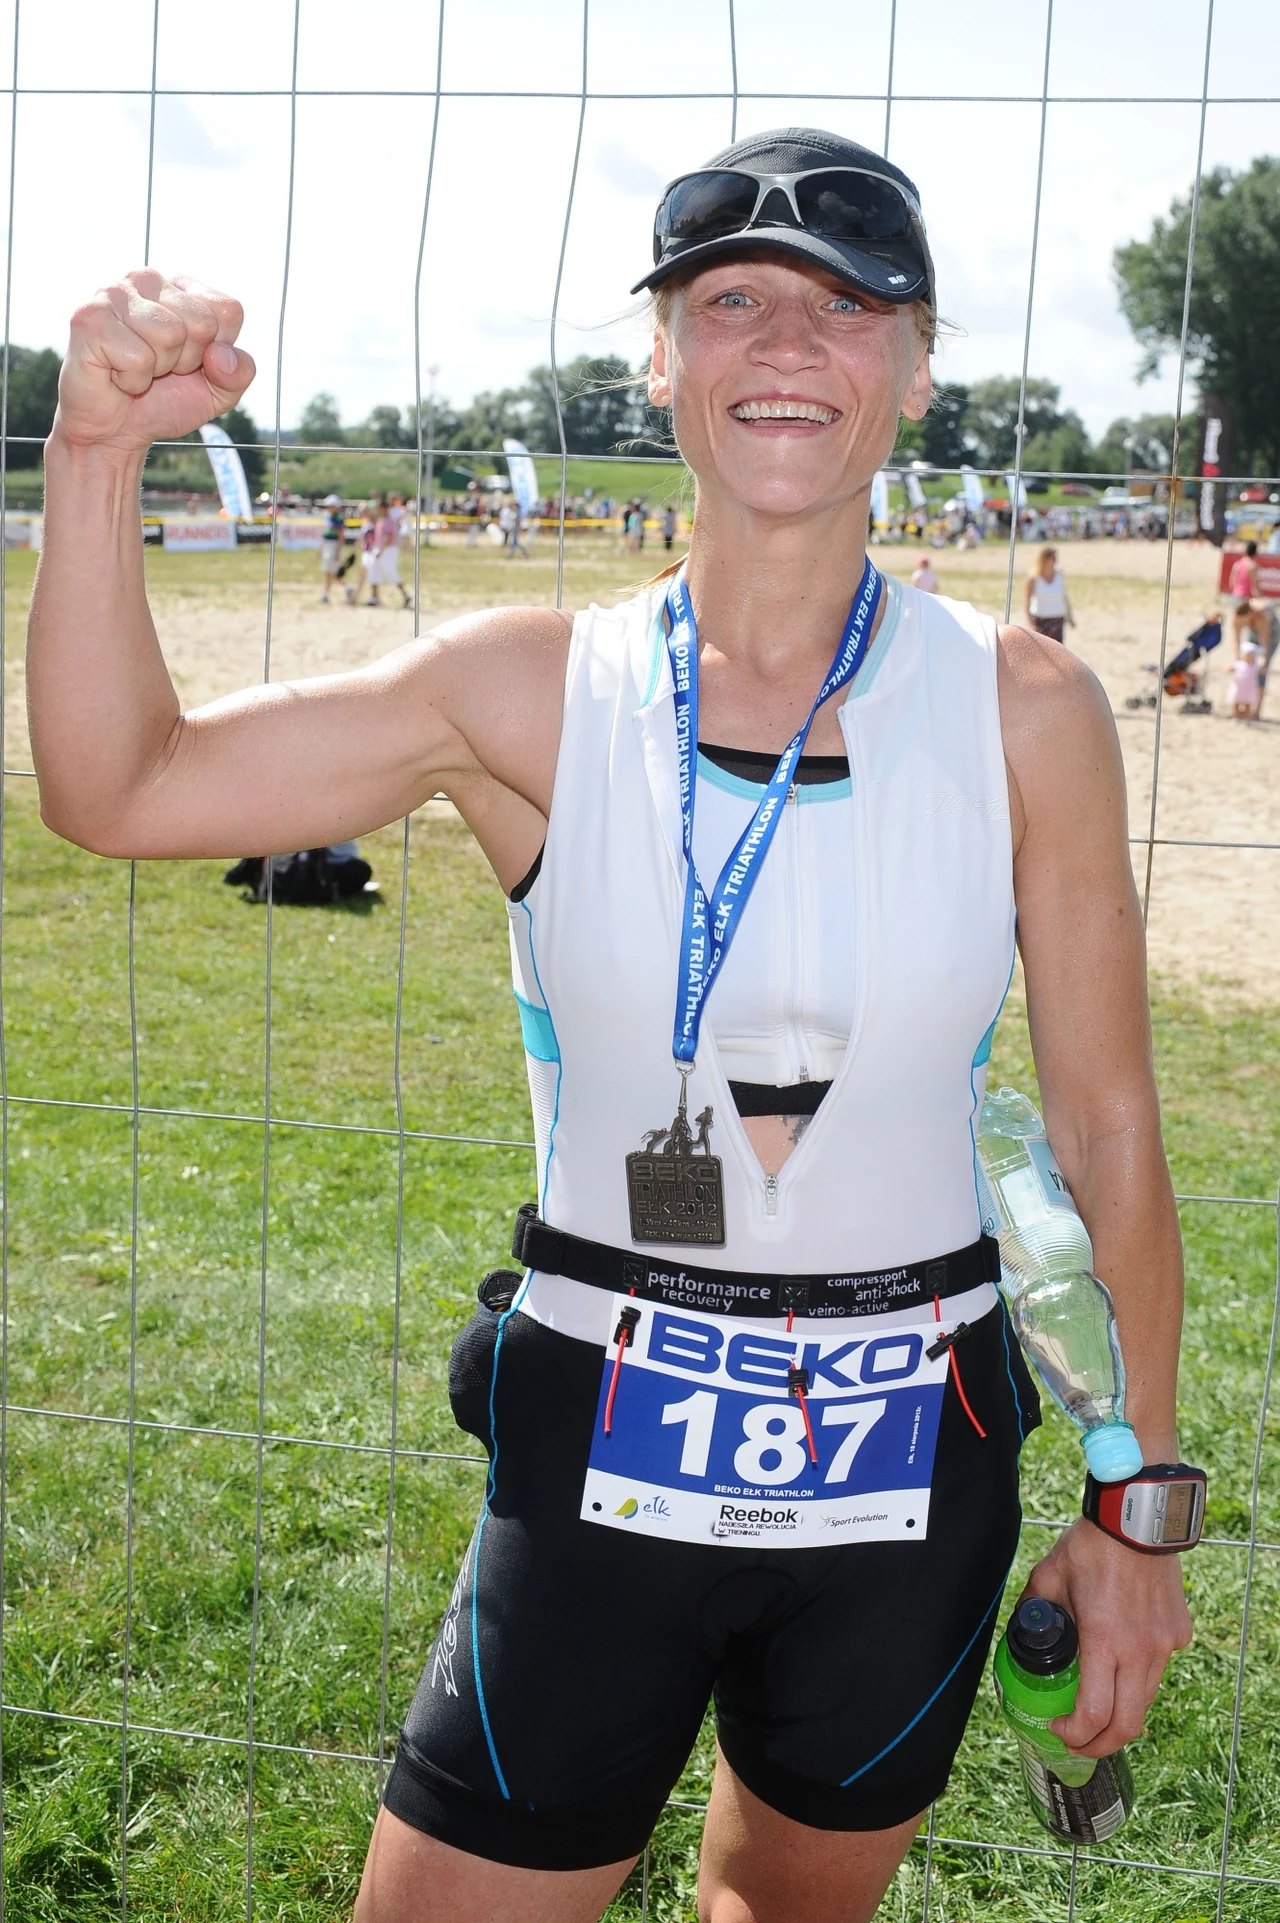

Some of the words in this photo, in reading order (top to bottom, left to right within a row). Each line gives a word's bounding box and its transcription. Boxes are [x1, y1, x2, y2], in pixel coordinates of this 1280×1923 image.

[864, 564, 877, 603] BEKO
[675, 645, 690, 692] BEKO
[817, 629, 861, 703] TRIATHLO
[677, 703, 690, 808] TRIATHLON
[776, 735, 800, 783] BEKO
[723, 797, 778, 896] TRIATHLON
[692, 888, 705, 929] EŁK
[714, 902, 734, 942] EŁK
[632, 1162, 718, 1182] BEKO
[632, 1182, 717, 1202] TRIATHLON
[676, 1202, 717, 1216] 2012
[648, 1271, 771, 1300] performance
[827, 1269, 907, 1289] compressport
[855, 1278, 921, 1301] anti-shock
[662, 1288, 733, 1313] recovery
[808, 1301, 889, 1317] veino-active
[647, 1311, 924, 1390] BEKO
[661, 1389, 887, 1486] 187
[714, 1484, 741, 1495] BEKO
[743, 1487, 762, 1496] EŁK
[764, 1489, 814, 1498] TRIATHLON
[718, 1521, 754, 1529] NADESZŁA
[720, 1505, 799, 1523] Reebok
[830, 1517, 851, 1528] Sport
[852, 1513, 888, 1524] Evolution
[1053, 1783, 1065, 1804] drink
